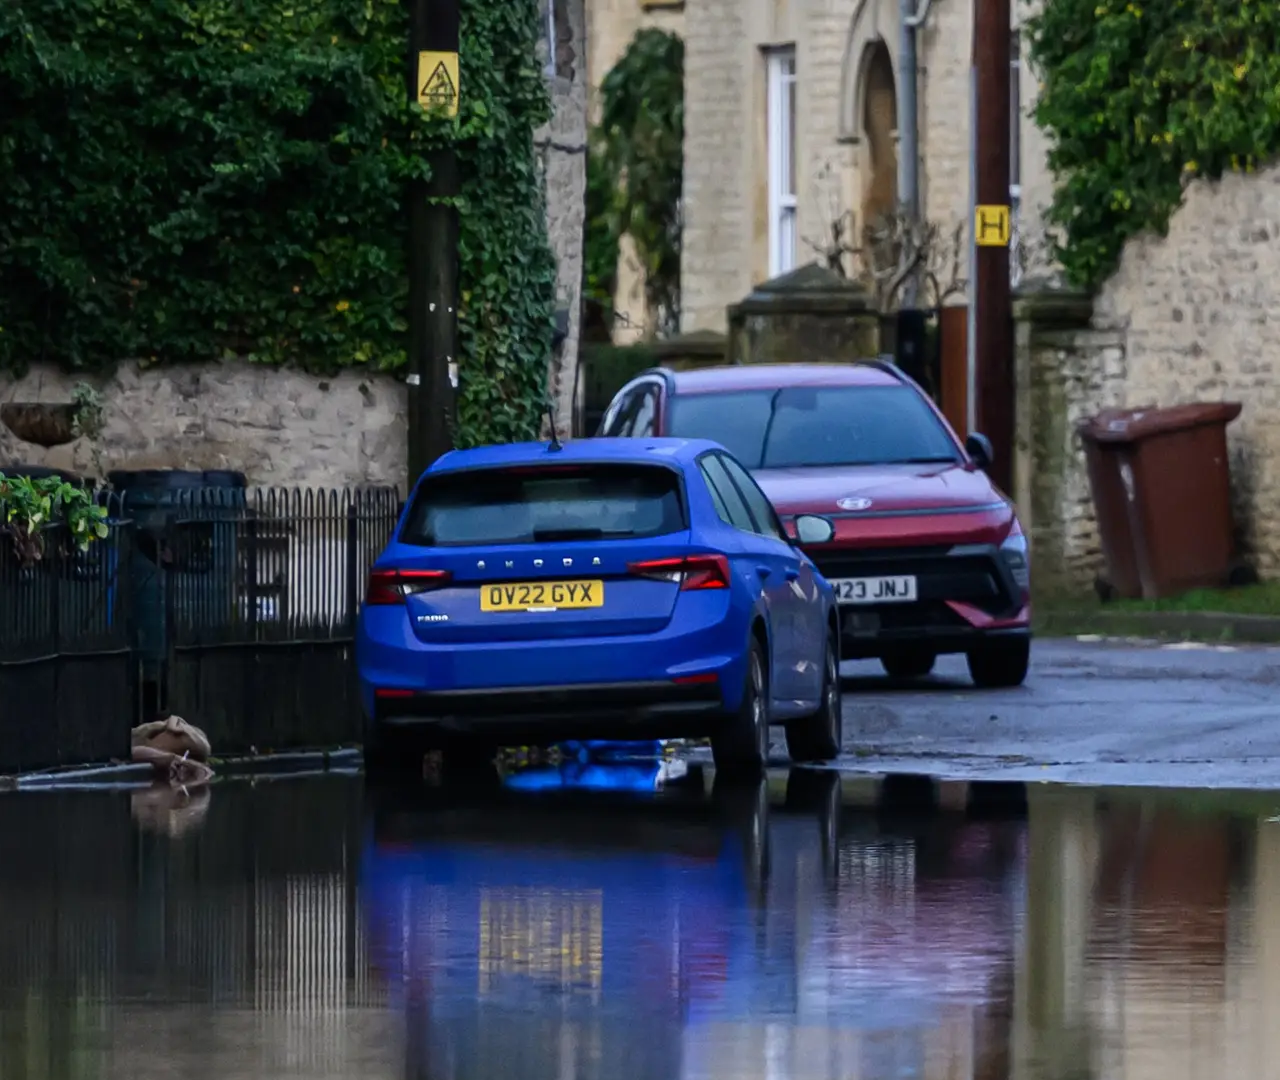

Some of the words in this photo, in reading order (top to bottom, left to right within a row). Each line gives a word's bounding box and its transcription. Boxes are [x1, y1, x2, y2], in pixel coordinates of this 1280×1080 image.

[980, 210, 1004, 240] H
[489, 586, 545, 606] OV22
[552, 583, 593, 603] GYX
[873, 579, 909, 598] JNJ
